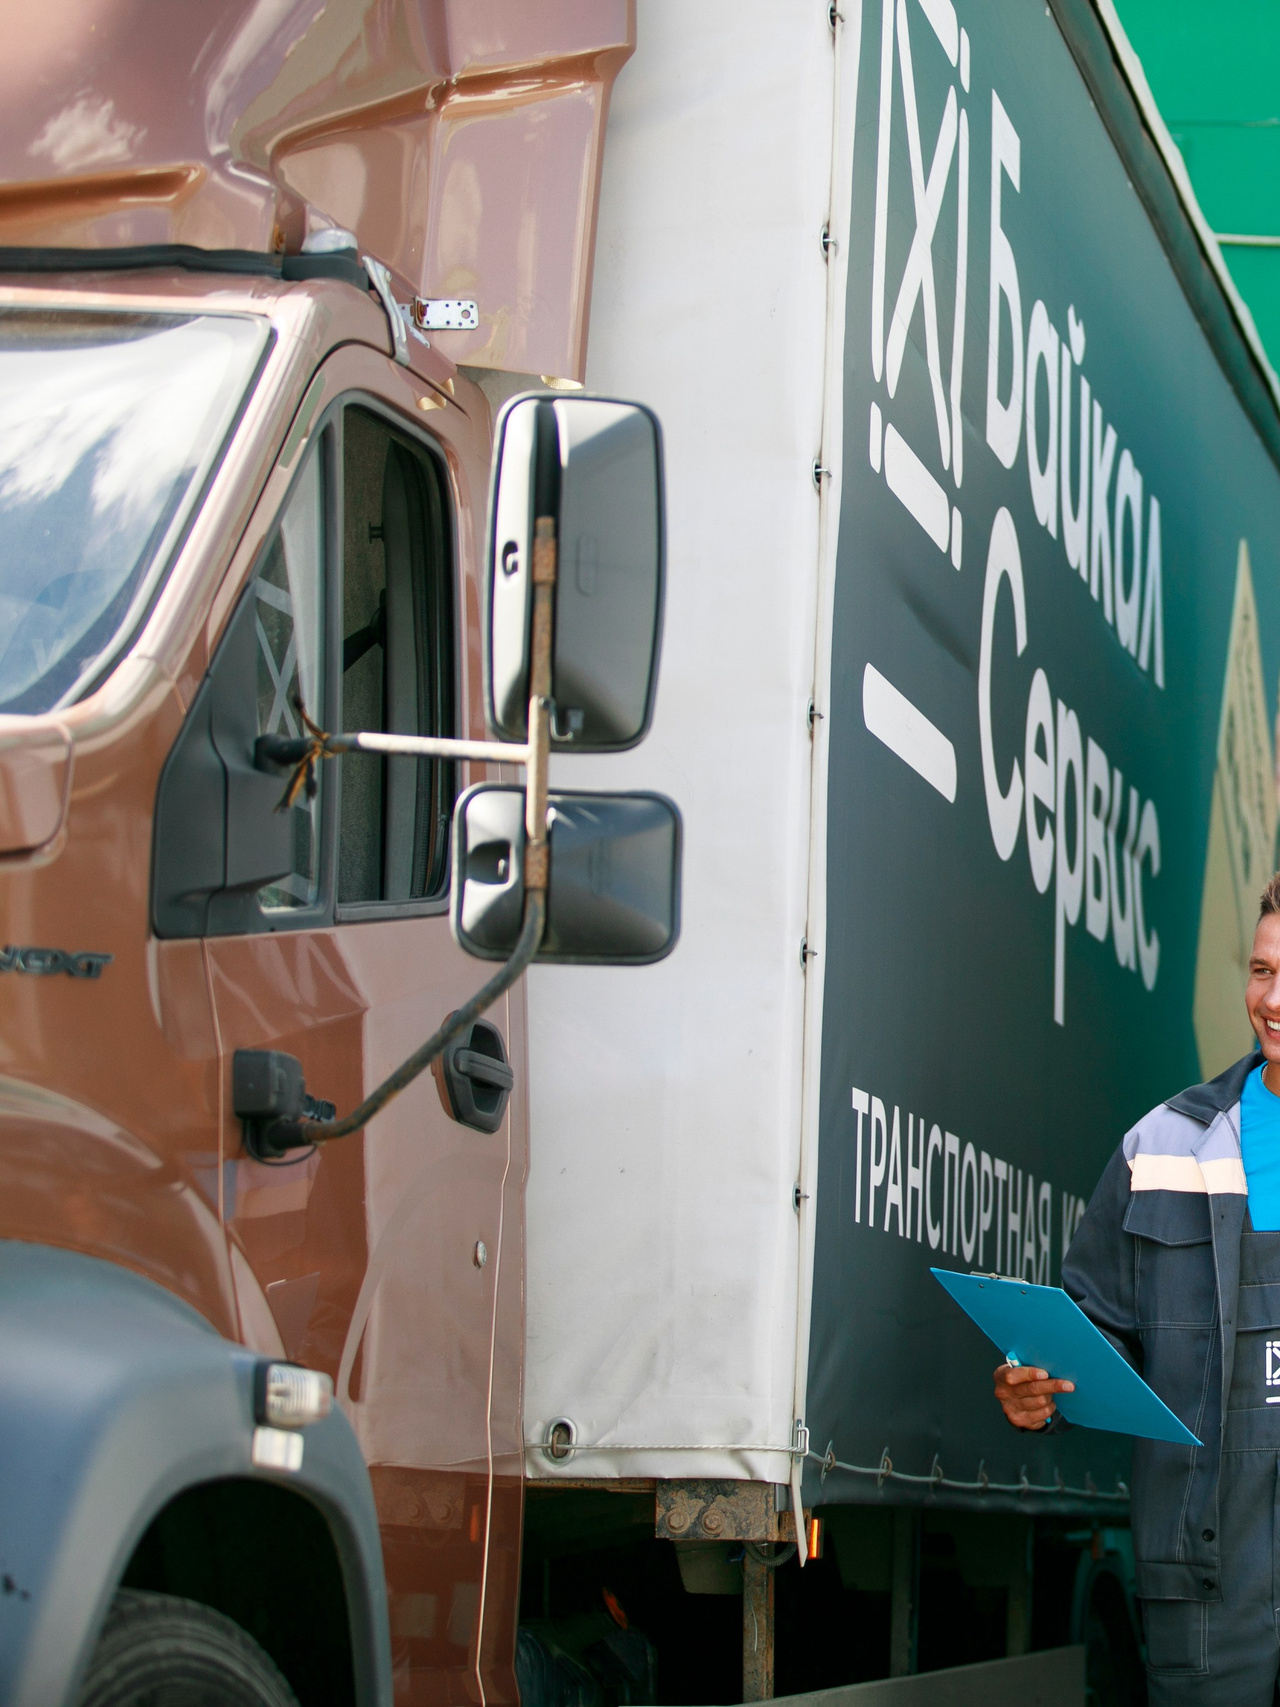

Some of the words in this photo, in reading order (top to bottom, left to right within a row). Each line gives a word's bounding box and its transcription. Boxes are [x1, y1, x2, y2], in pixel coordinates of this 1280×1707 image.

[986, 88, 1163, 690] Байкал
[978, 505, 1160, 1027] Сервис
[851, 1086, 1052, 1287] ТРАНСПОРТНАЯ
